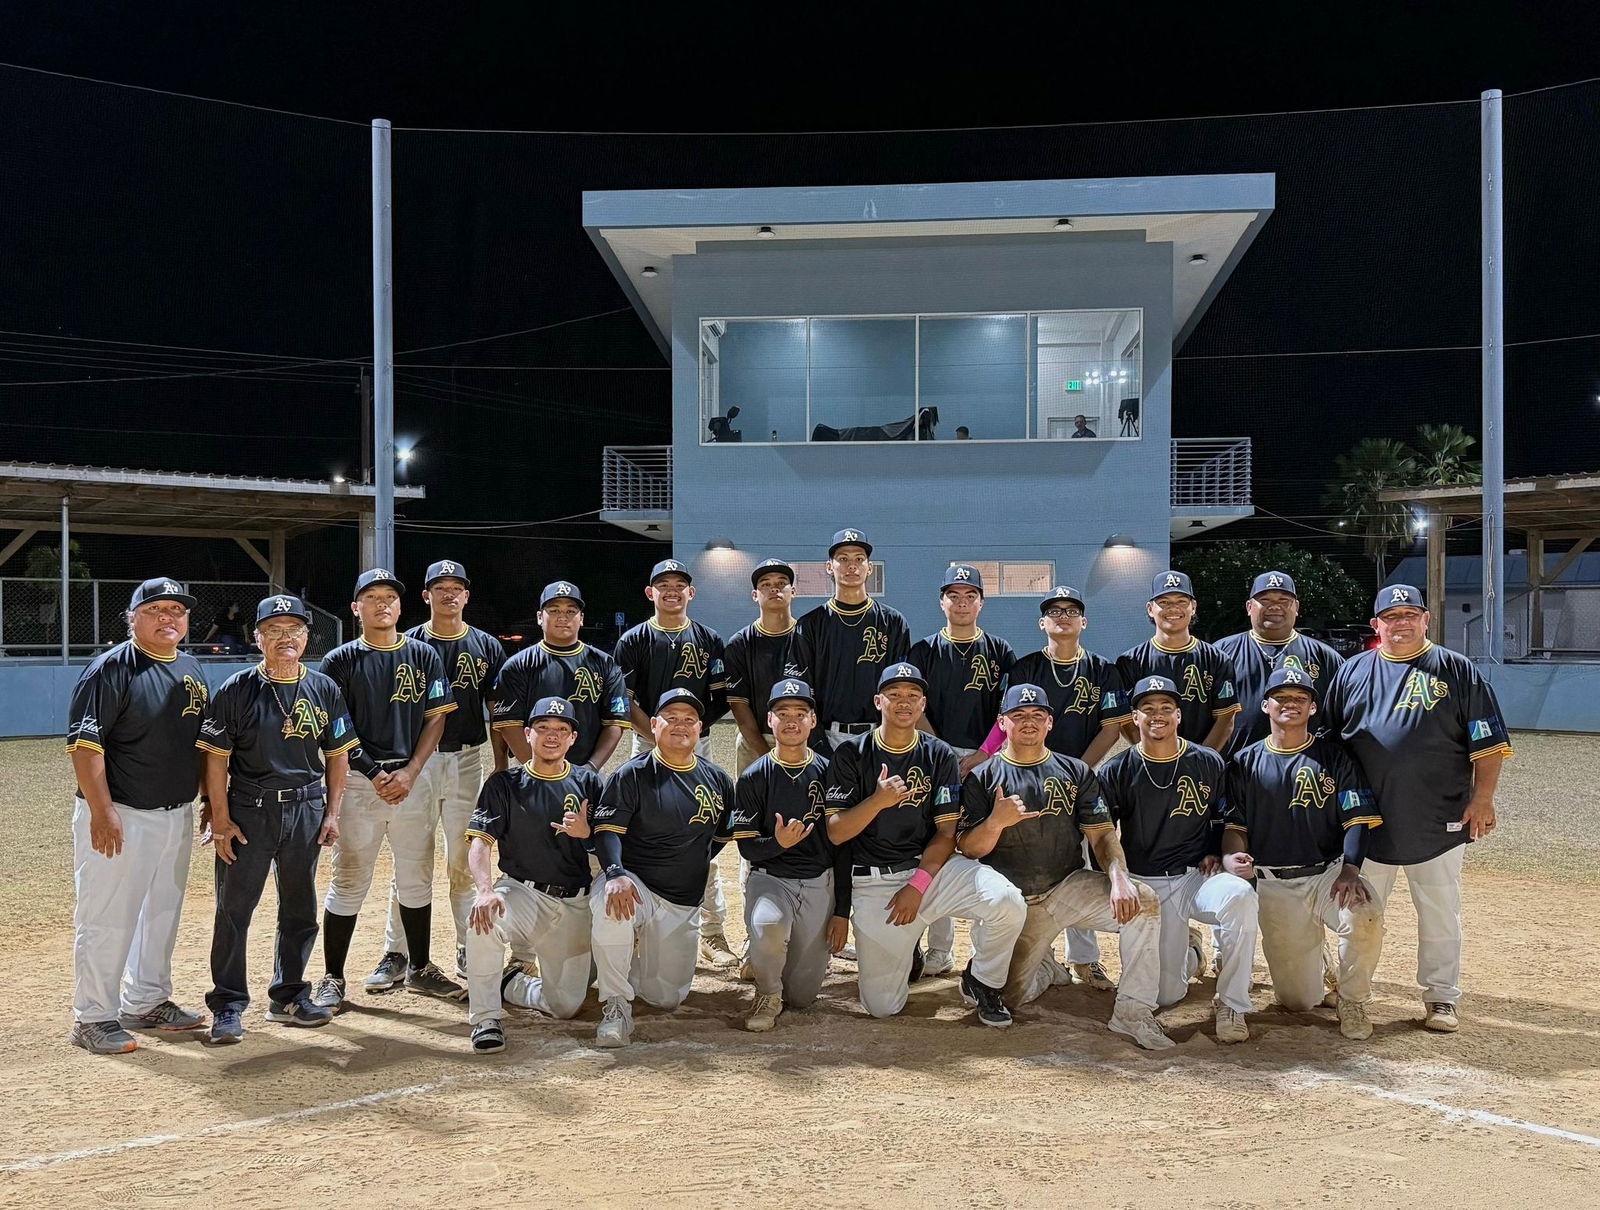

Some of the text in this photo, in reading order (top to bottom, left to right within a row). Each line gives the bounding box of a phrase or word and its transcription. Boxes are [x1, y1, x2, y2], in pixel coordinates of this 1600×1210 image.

[390, 663, 427, 703] A's
[451, 652, 489, 690] A's
[1394, 671, 1449, 711] A's
[1019, 687, 1037, 703] A's
[1064, 676, 1101, 714] A's
[285, 698, 329, 740] A's
[1039, 776, 1079, 817] A's
[1170, 775, 1211, 819] A's
[1288, 766, 1336, 809] A's
